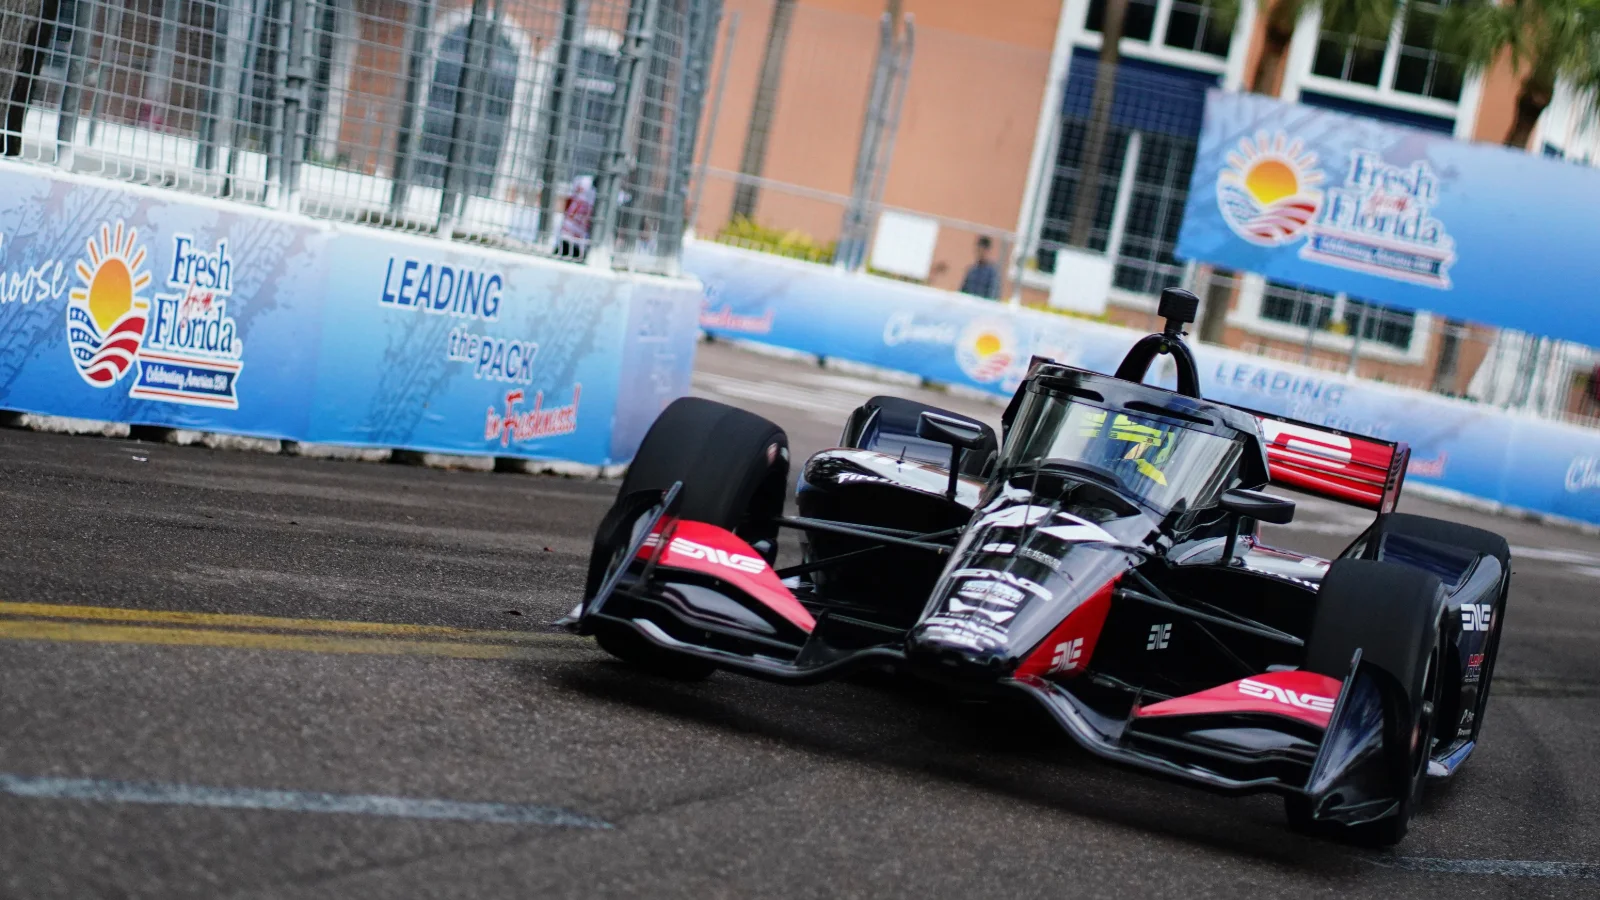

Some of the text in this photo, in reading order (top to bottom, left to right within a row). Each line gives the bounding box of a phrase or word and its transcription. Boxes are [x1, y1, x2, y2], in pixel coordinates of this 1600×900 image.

[1350, 152, 1434, 200] Fresh
[1326, 193, 1439, 243] Florida
[170, 236, 232, 290] Fresh
[382, 257, 503, 318] LEADING
[152, 298, 233, 353] Florida
[450, 327, 537, 382] the PACK
[1214, 361, 1346, 403] LEADING
